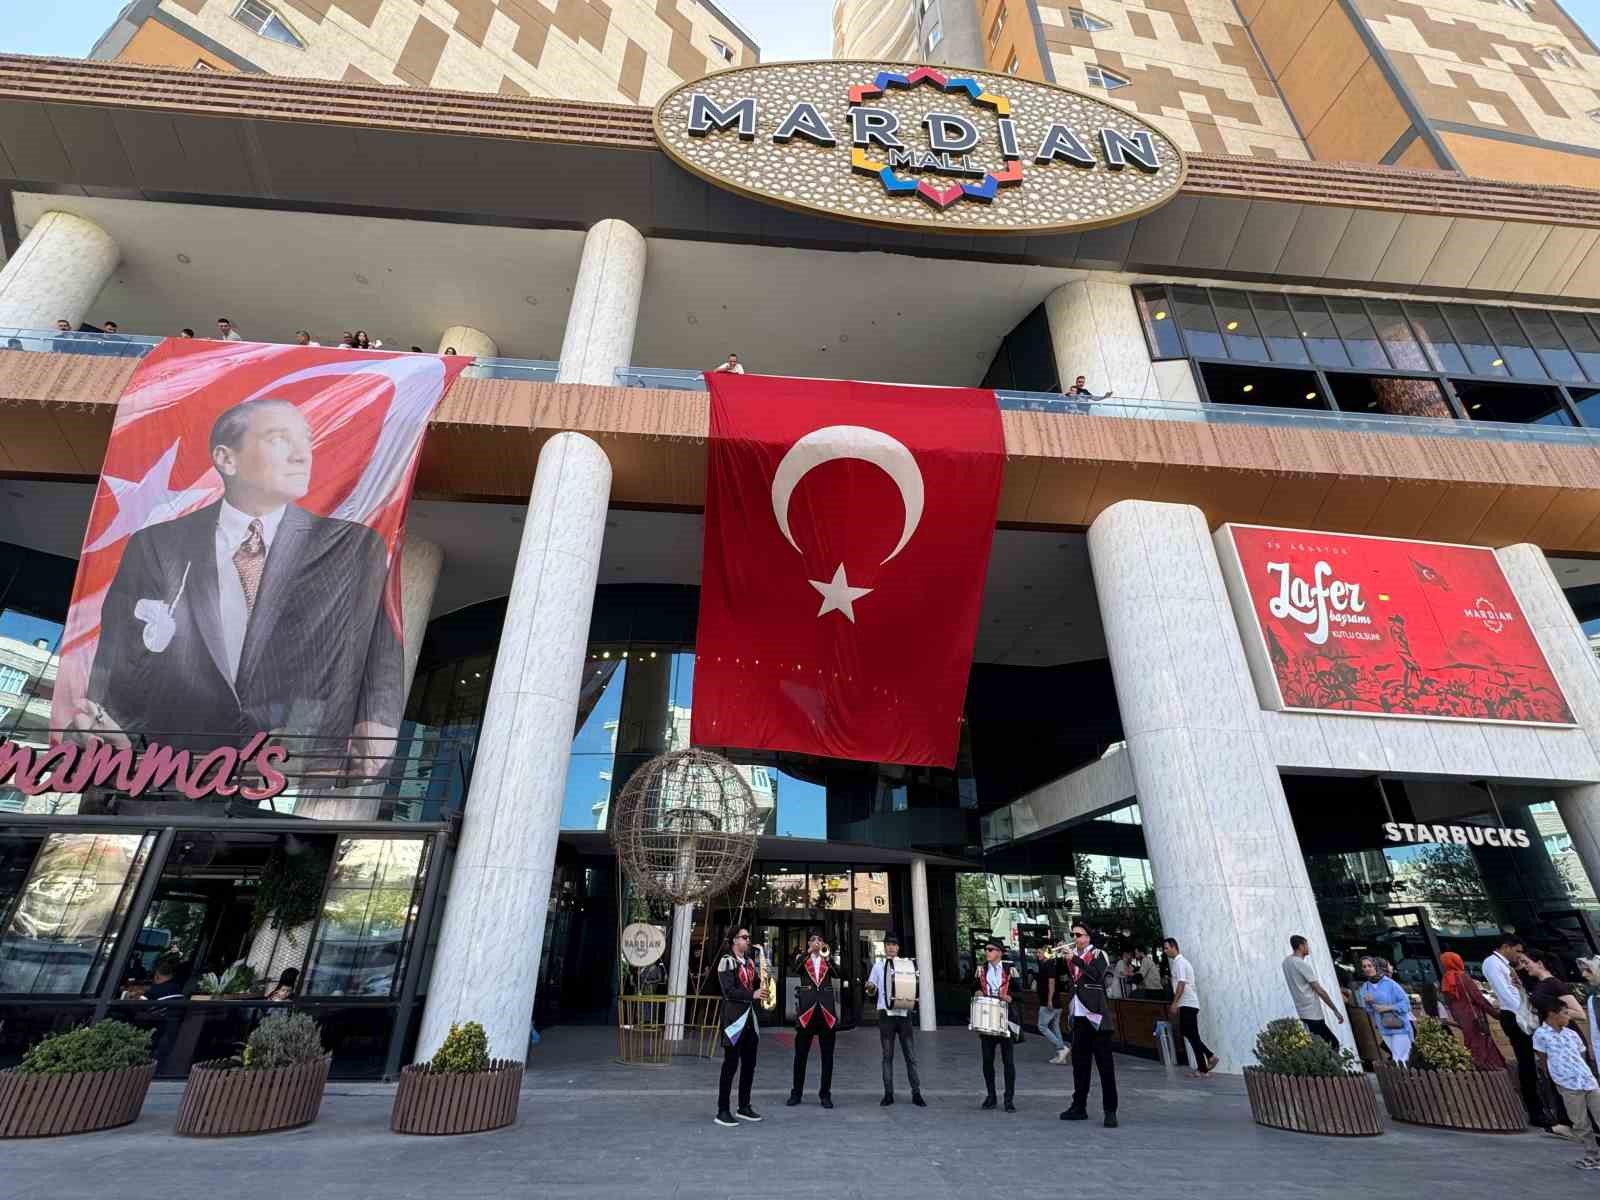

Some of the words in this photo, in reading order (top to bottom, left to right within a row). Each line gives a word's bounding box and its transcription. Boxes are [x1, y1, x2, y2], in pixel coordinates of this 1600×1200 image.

[688, 94, 1160, 172] MARDIAN
[888, 147, 986, 175] MALL
[1463, 608, 1513, 621] MARDIAN
[1384, 821, 1530, 848] STARBUCKS
